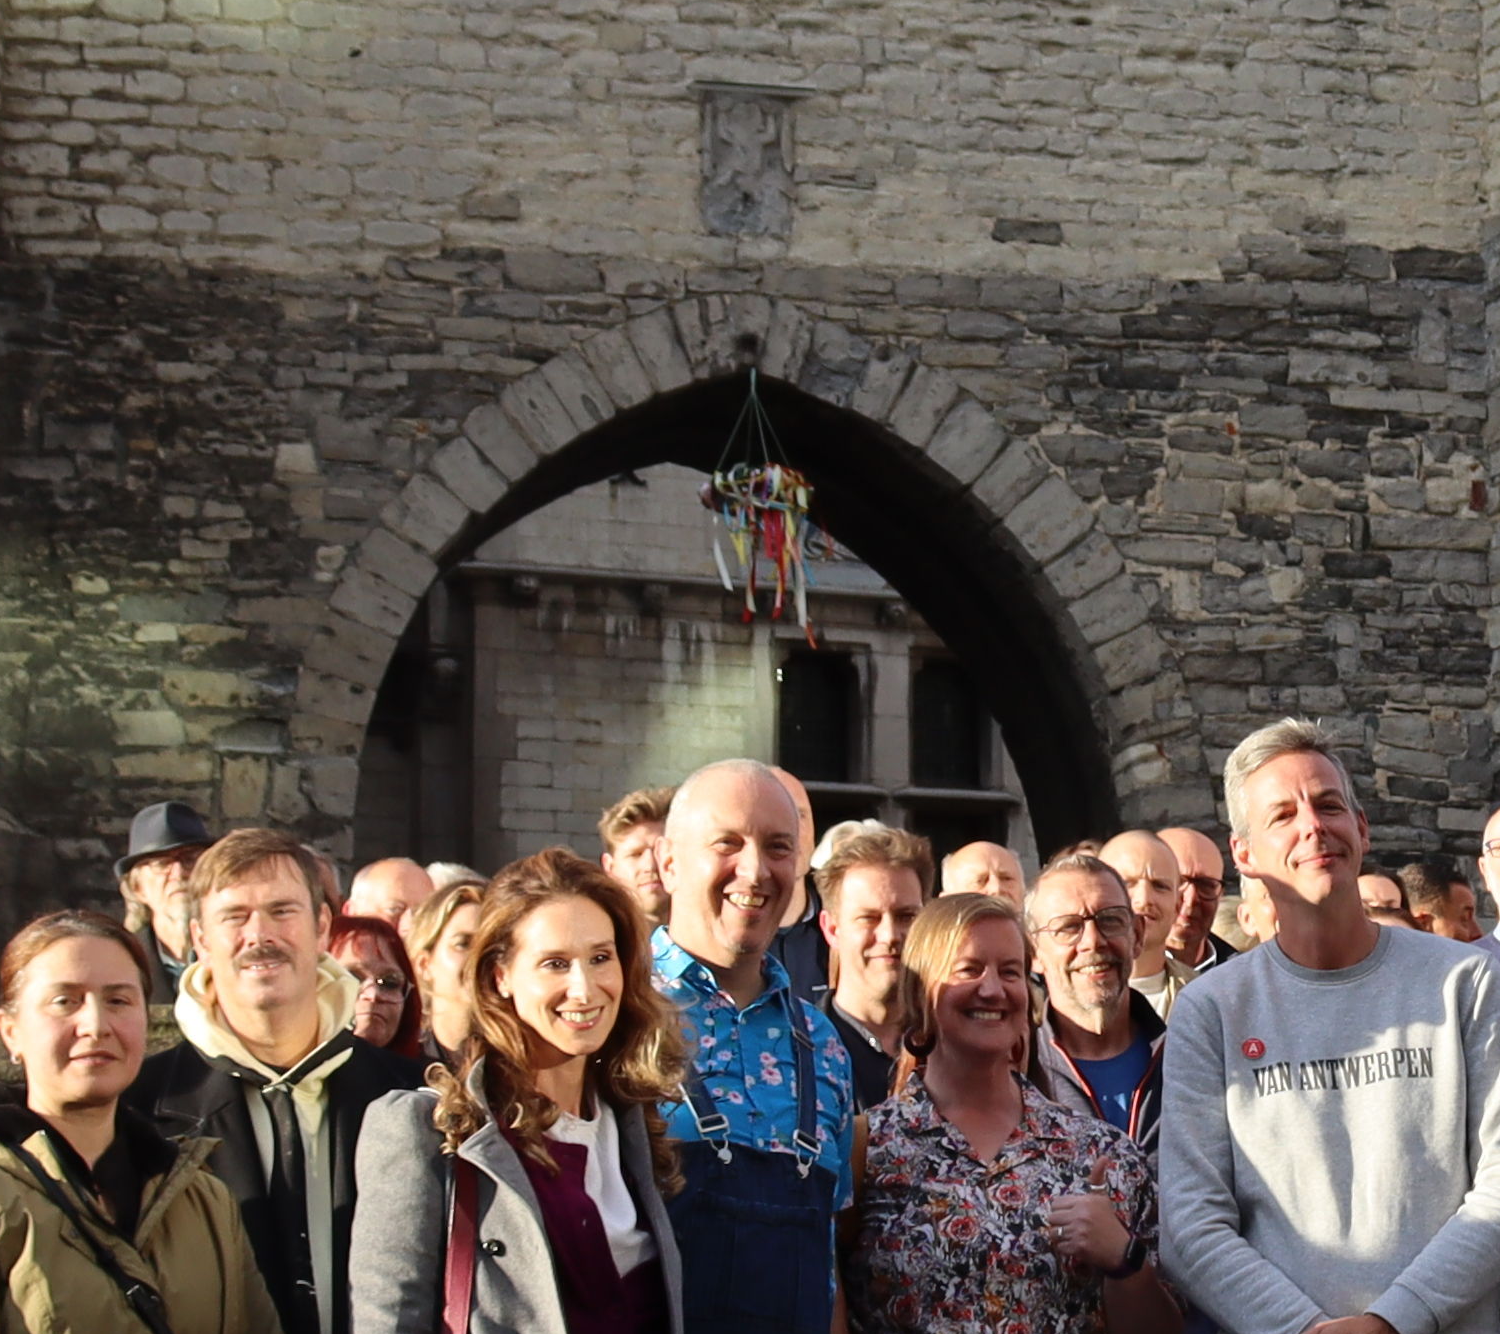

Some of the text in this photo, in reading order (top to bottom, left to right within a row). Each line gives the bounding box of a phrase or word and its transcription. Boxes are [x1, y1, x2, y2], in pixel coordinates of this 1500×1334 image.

[1248, 1042, 1259, 1053] A
[1252, 1046, 1435, 1098] VAN ANTWERPEN
